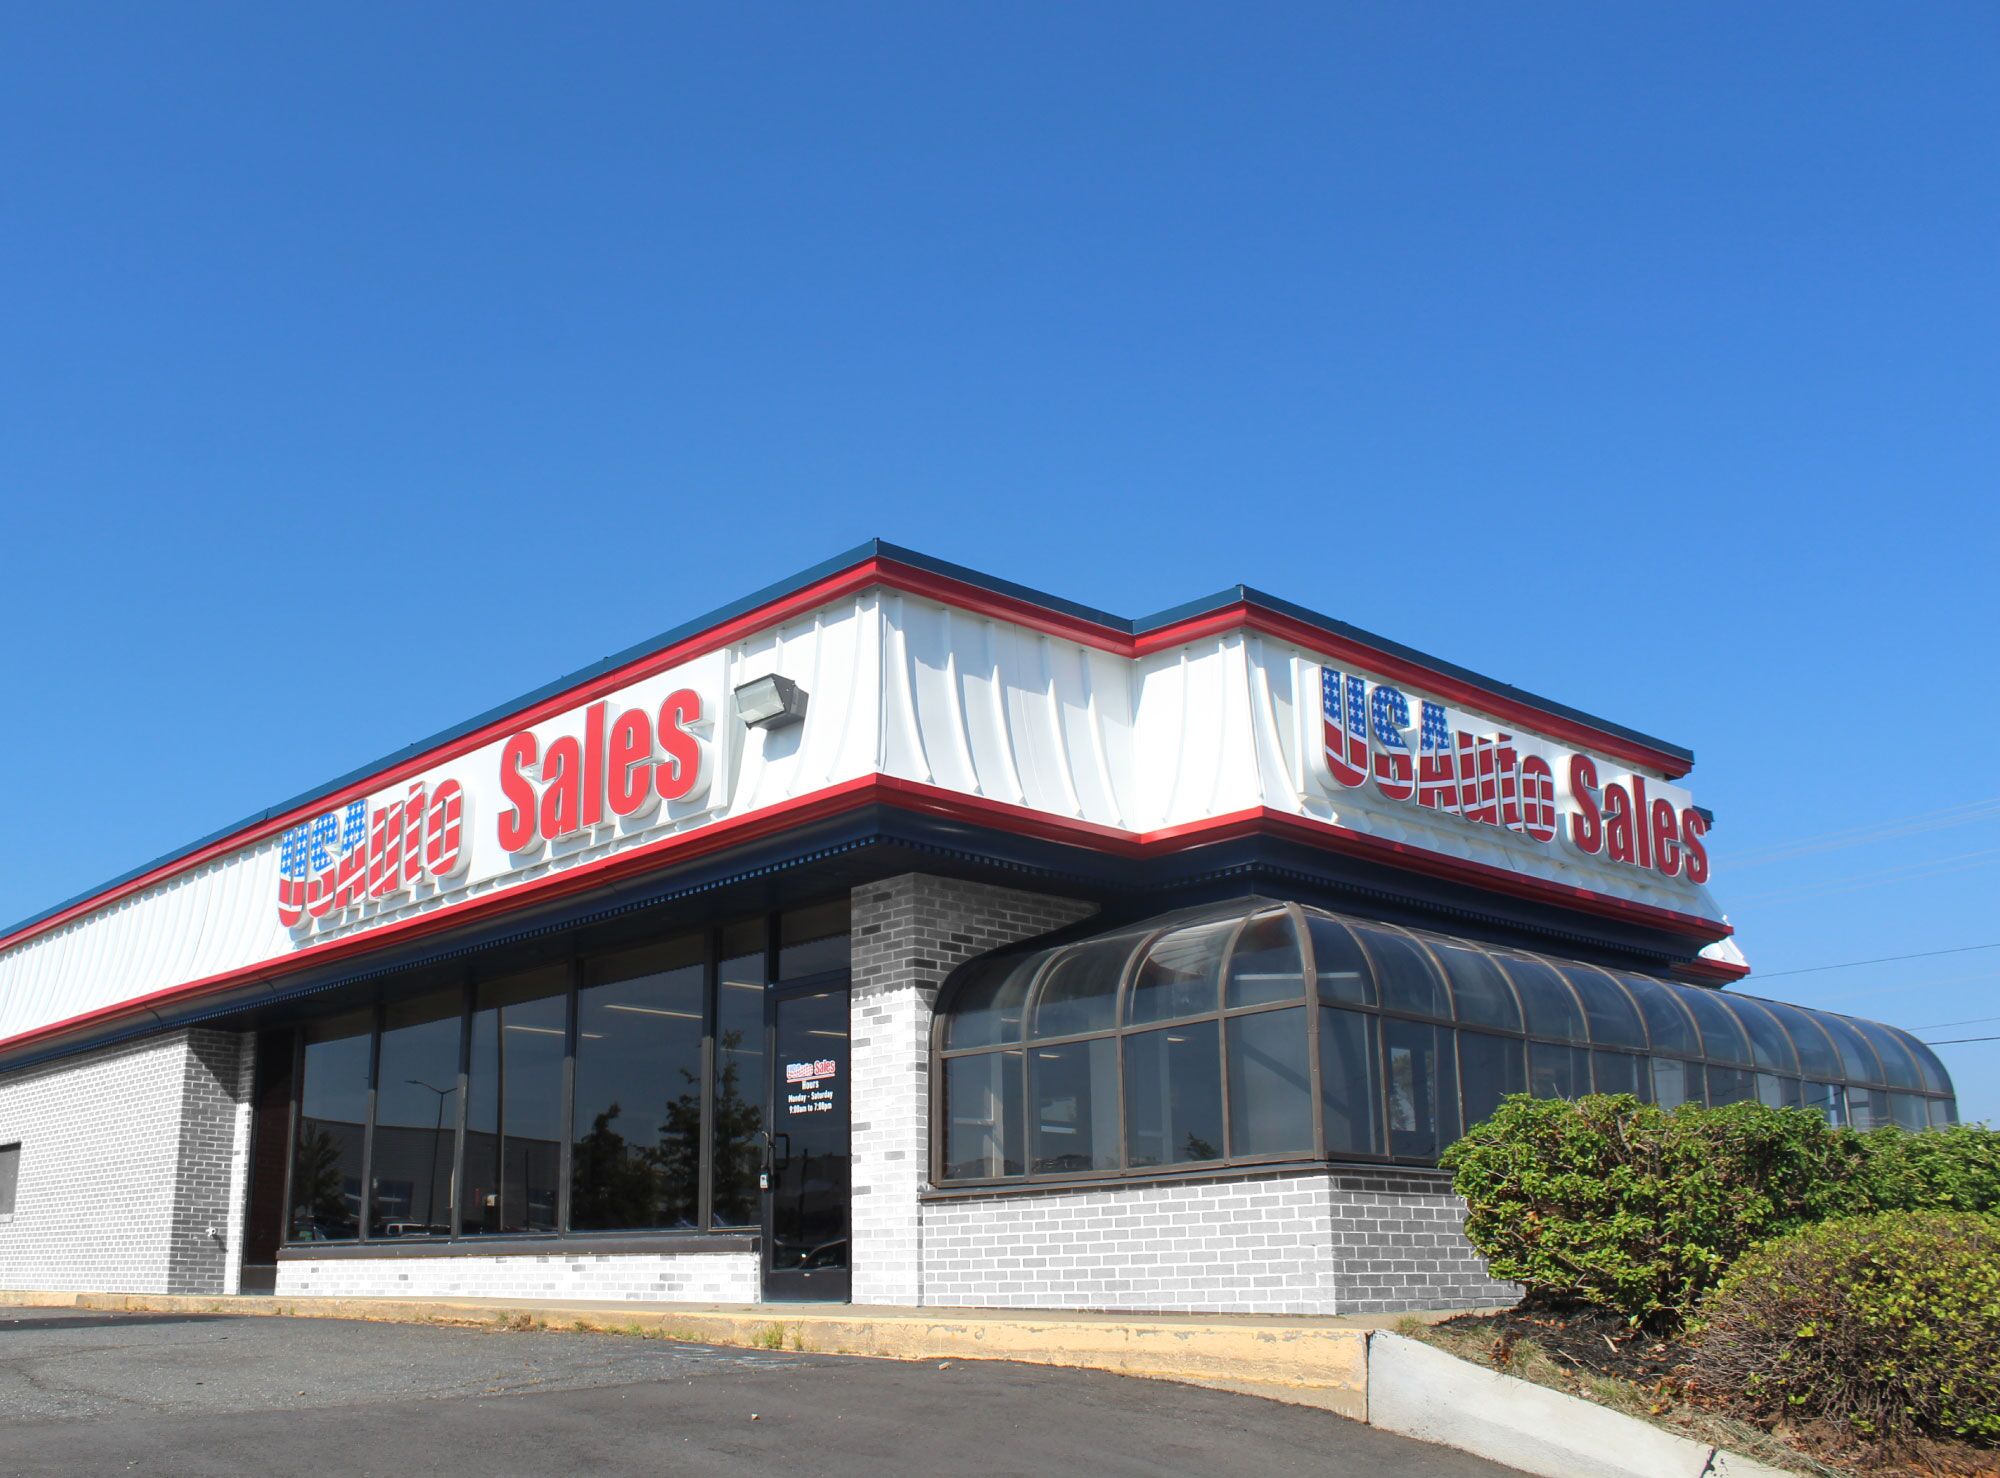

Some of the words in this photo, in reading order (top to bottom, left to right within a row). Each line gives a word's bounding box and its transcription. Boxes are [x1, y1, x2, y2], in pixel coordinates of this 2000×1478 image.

[498, 688, 703, 853] Sales
[1568, 753, 1710, 884] Sales
[814, 1059, 836, 1075] Sales
[801, 1080, 819, 1090] Hours
[788, 1094, 807, 1103] Monday
[811, 1090, 833, 1101] Saturday
[807, 1104, 813, 1112] to
